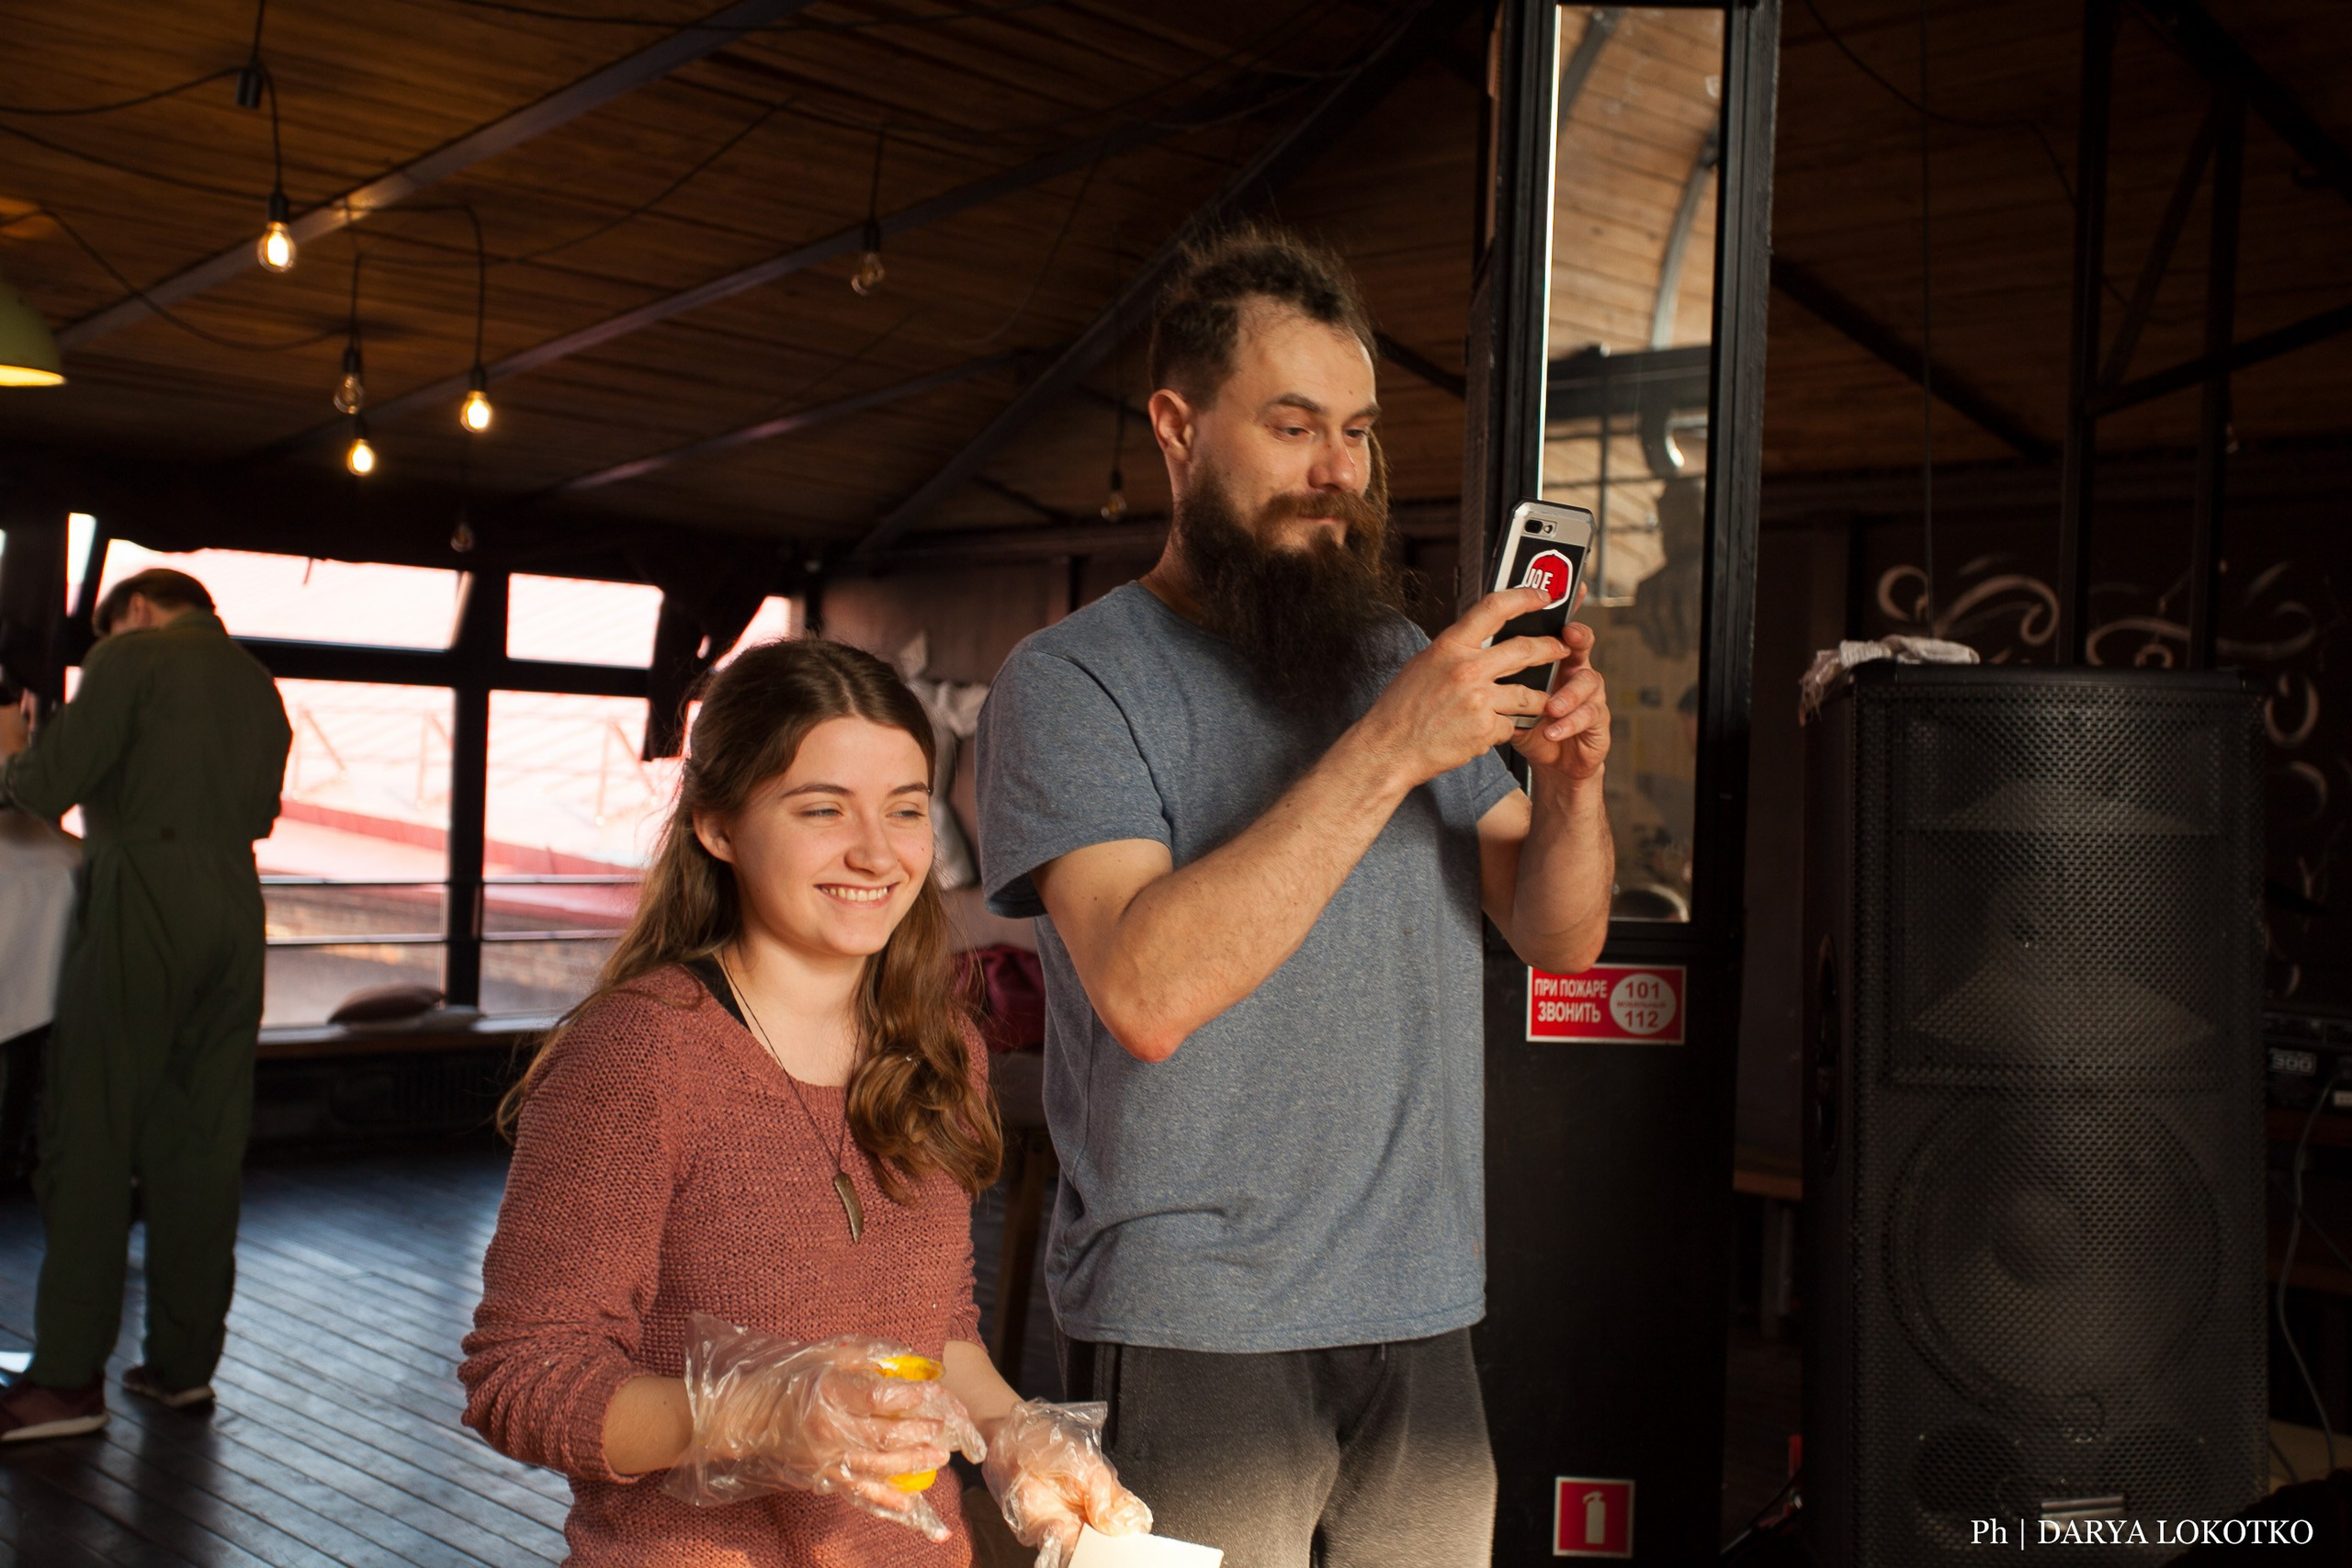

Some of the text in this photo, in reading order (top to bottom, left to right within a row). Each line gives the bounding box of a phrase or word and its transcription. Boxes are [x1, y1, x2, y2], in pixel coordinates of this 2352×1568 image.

[1534, 978, 1607, 998] ПРИ ПОЖАРЕ
[1624, 982, 1660, 998] 101
[1537, 1001, 1601, 1022] ЗВОНИТЬ
[1624, 1011, 1659, 1028] 112
